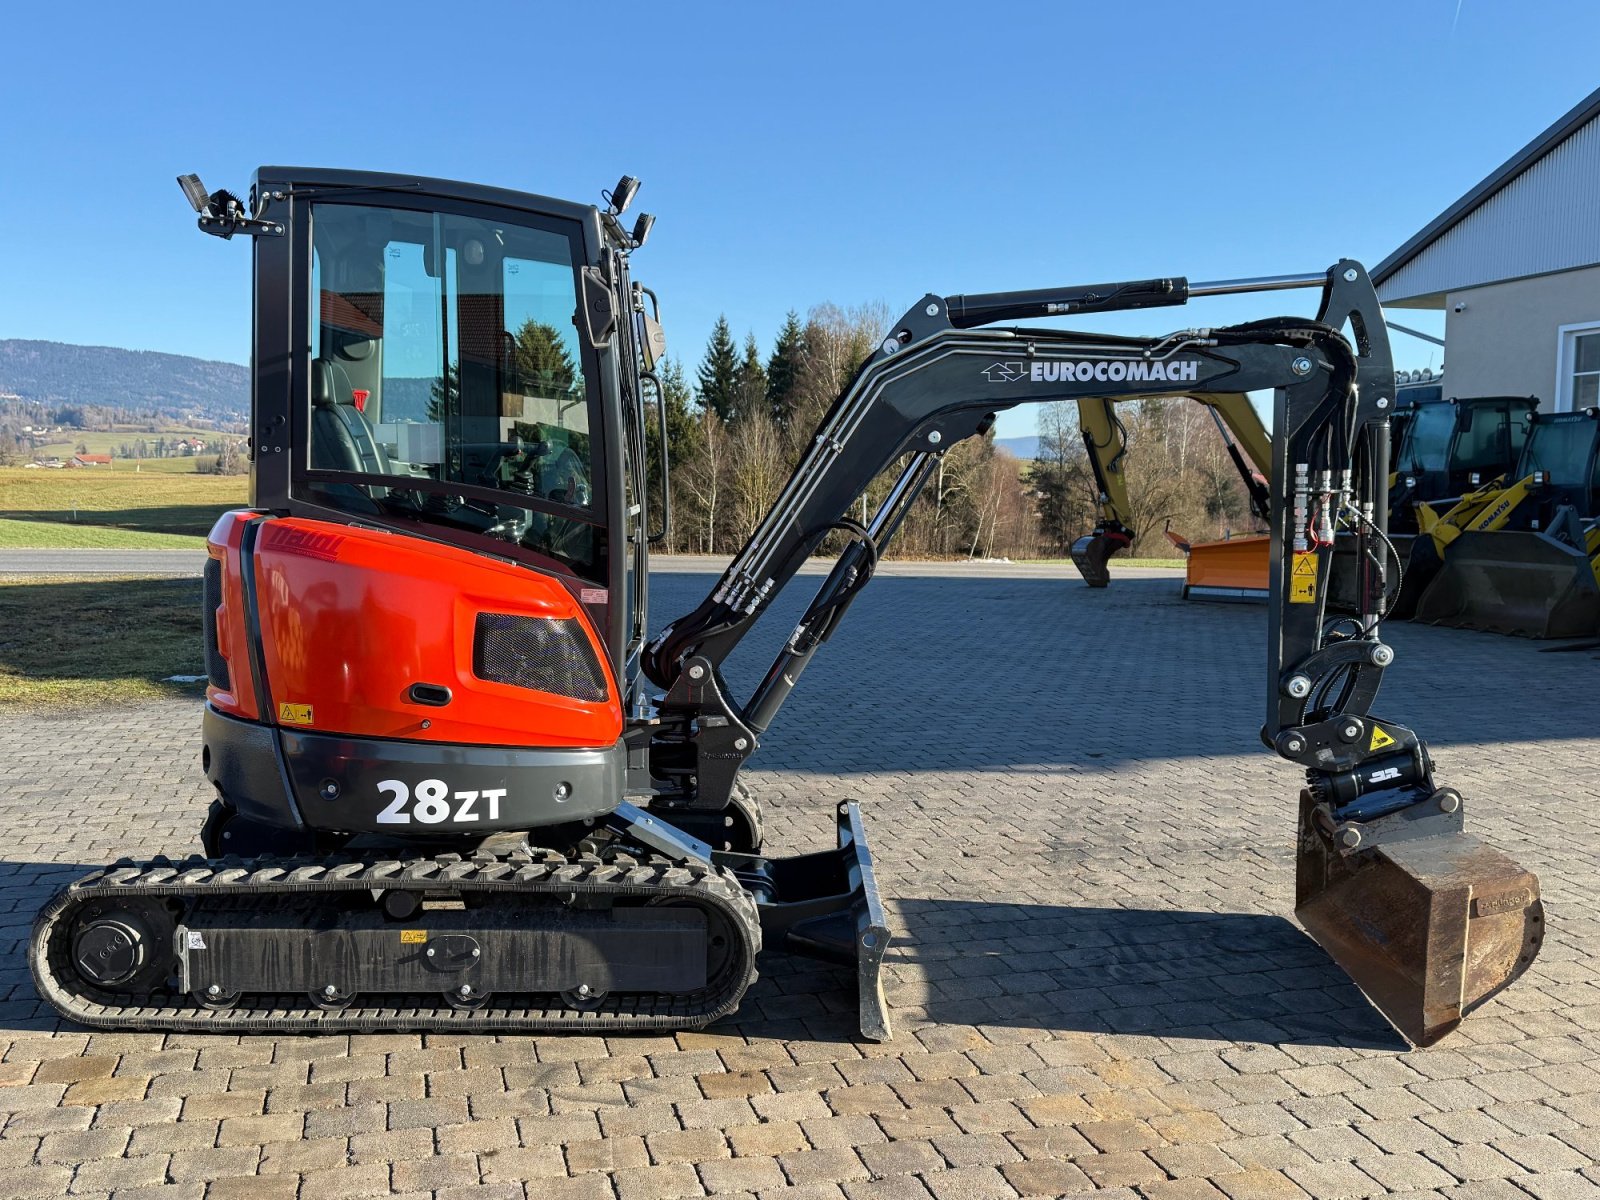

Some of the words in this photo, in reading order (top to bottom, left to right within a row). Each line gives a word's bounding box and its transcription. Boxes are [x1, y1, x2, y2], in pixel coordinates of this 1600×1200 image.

[1031, 361, 1198, 381] EUROCOMACH
[1478, 499, 1510, 530] KOMATSU
[376, 779, 507, 824] 28ZT
